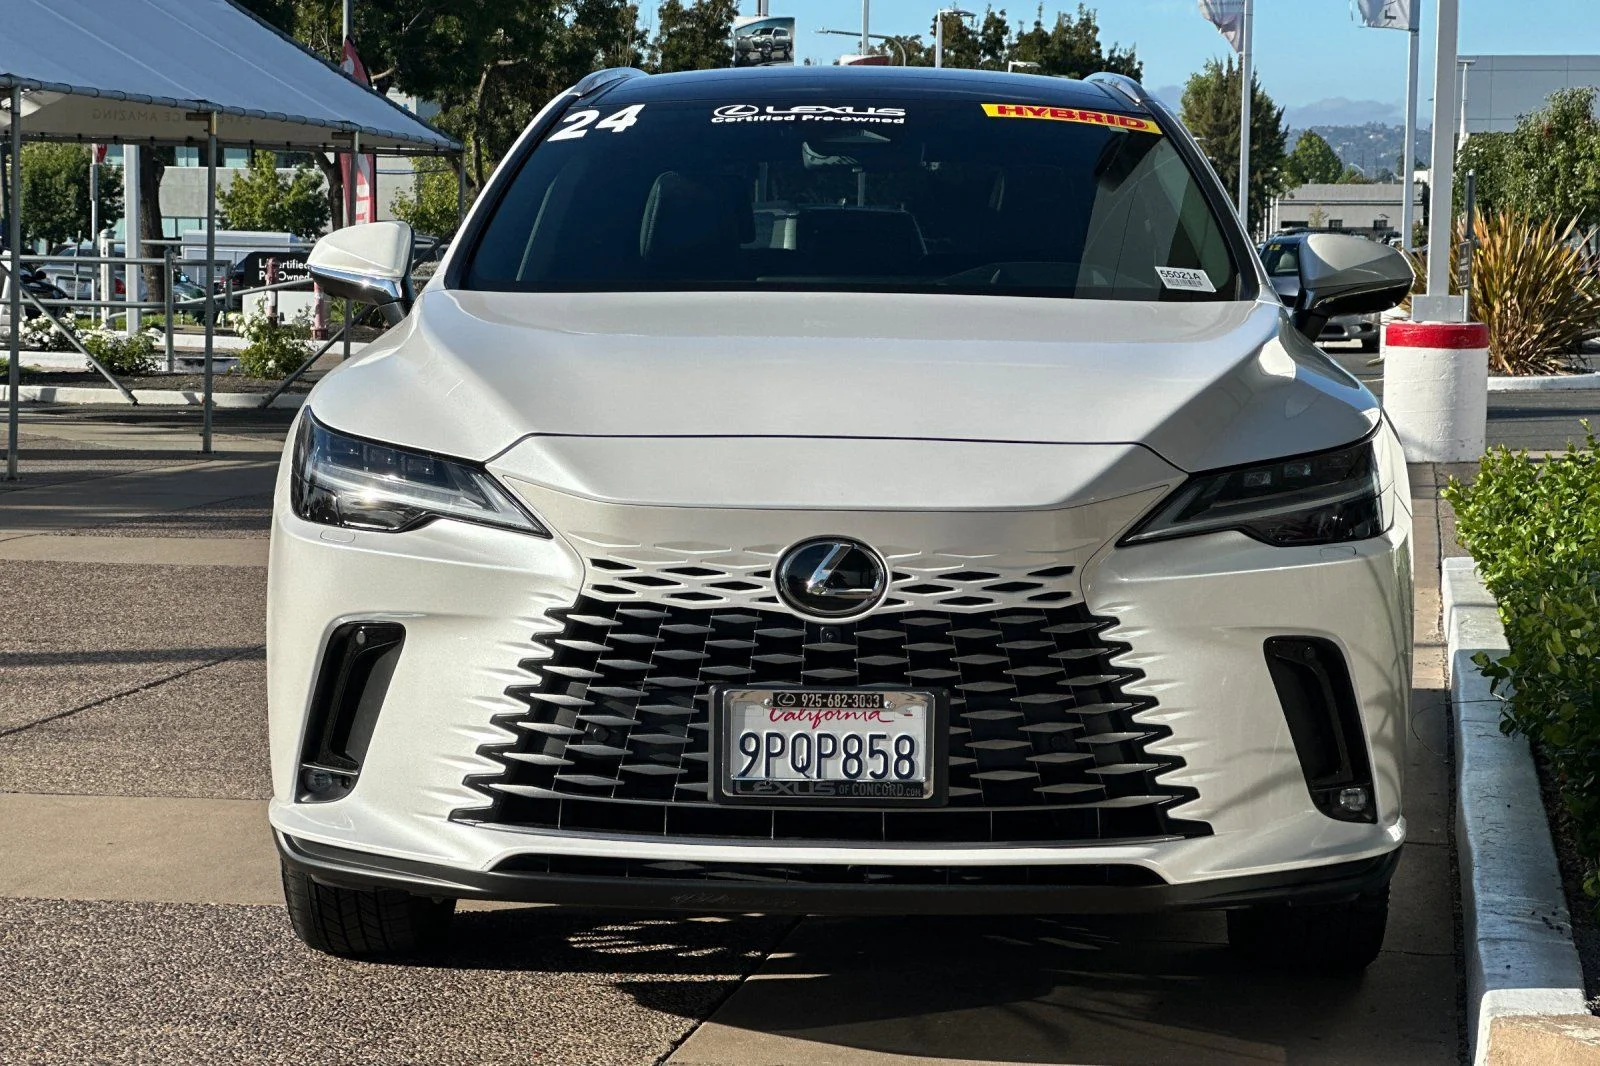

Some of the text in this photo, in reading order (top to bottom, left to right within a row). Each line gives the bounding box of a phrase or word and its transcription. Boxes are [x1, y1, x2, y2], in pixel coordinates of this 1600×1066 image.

[765, 105, 906, 116] LEXUS
[997, 105, 1150, 130] HYBRID
[547, 104, 646, 142] 24
[711, 114, 905, 124] Certified Pre-owned
[1160, 270, 1202, 281] 55021A
[801, 693, 880, 708] 925-682-3033
[769, 707, 895, 730] California
[737, 731, 916, 780] 9PQP858
[735, 780, 836, 796] LEXUS
[838, 786, 850, 795] OF
